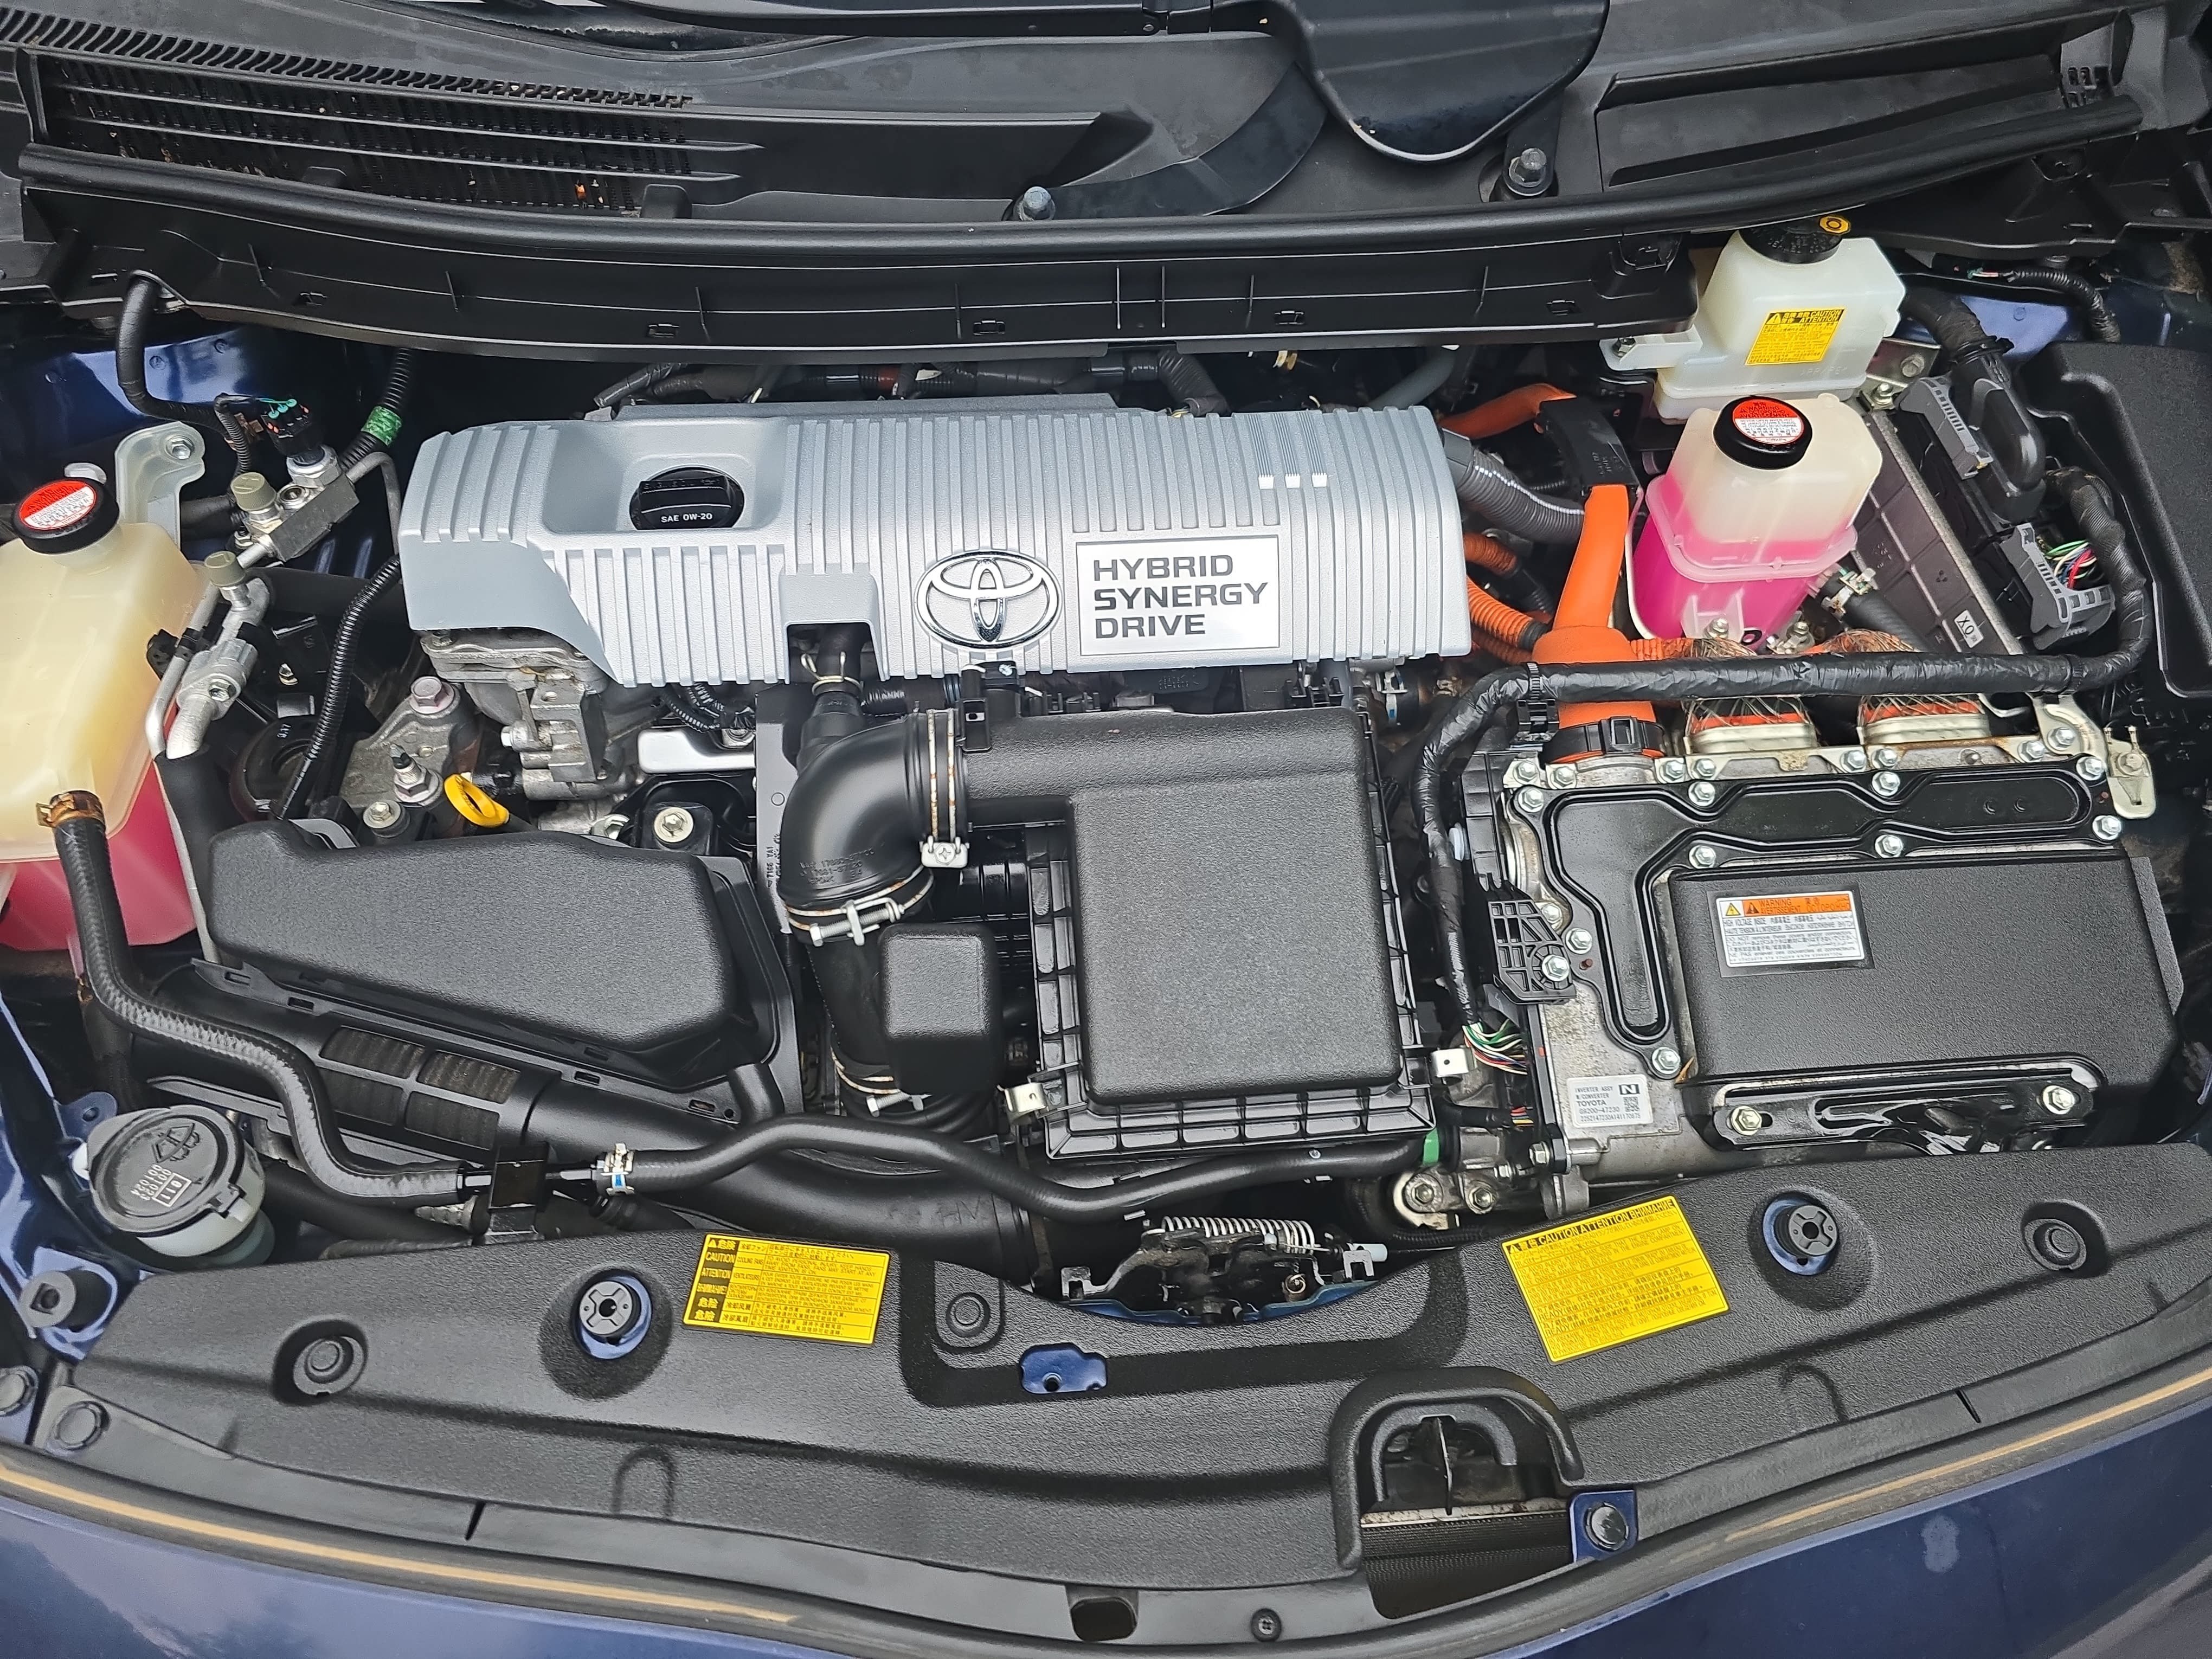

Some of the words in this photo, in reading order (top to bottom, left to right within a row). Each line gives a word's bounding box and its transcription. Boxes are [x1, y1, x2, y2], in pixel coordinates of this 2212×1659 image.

[661, 514, 679, 523] SAE
[683, 512, 713, 521] 0W-20
[1093, 555, 1233, 581] HYBRID
[1094, 582, 1269, 610] SYNERGY
[1095, 614, 1206, 639] DRIVE
[1758, 898, 1792, 907] WARNING
[1621, 1084, 1637, 1094] N
[1629, 1200, 1674, 1219] ВНИМАНИЕ
[1538, 1226, 1580, 1245] CAUTION
[1579, 1212, 1630, 1234] ATTENTION
[704, 1251, 736, 1263] CAUTION
[700, 1267, 732, 1278] ATTENTION
